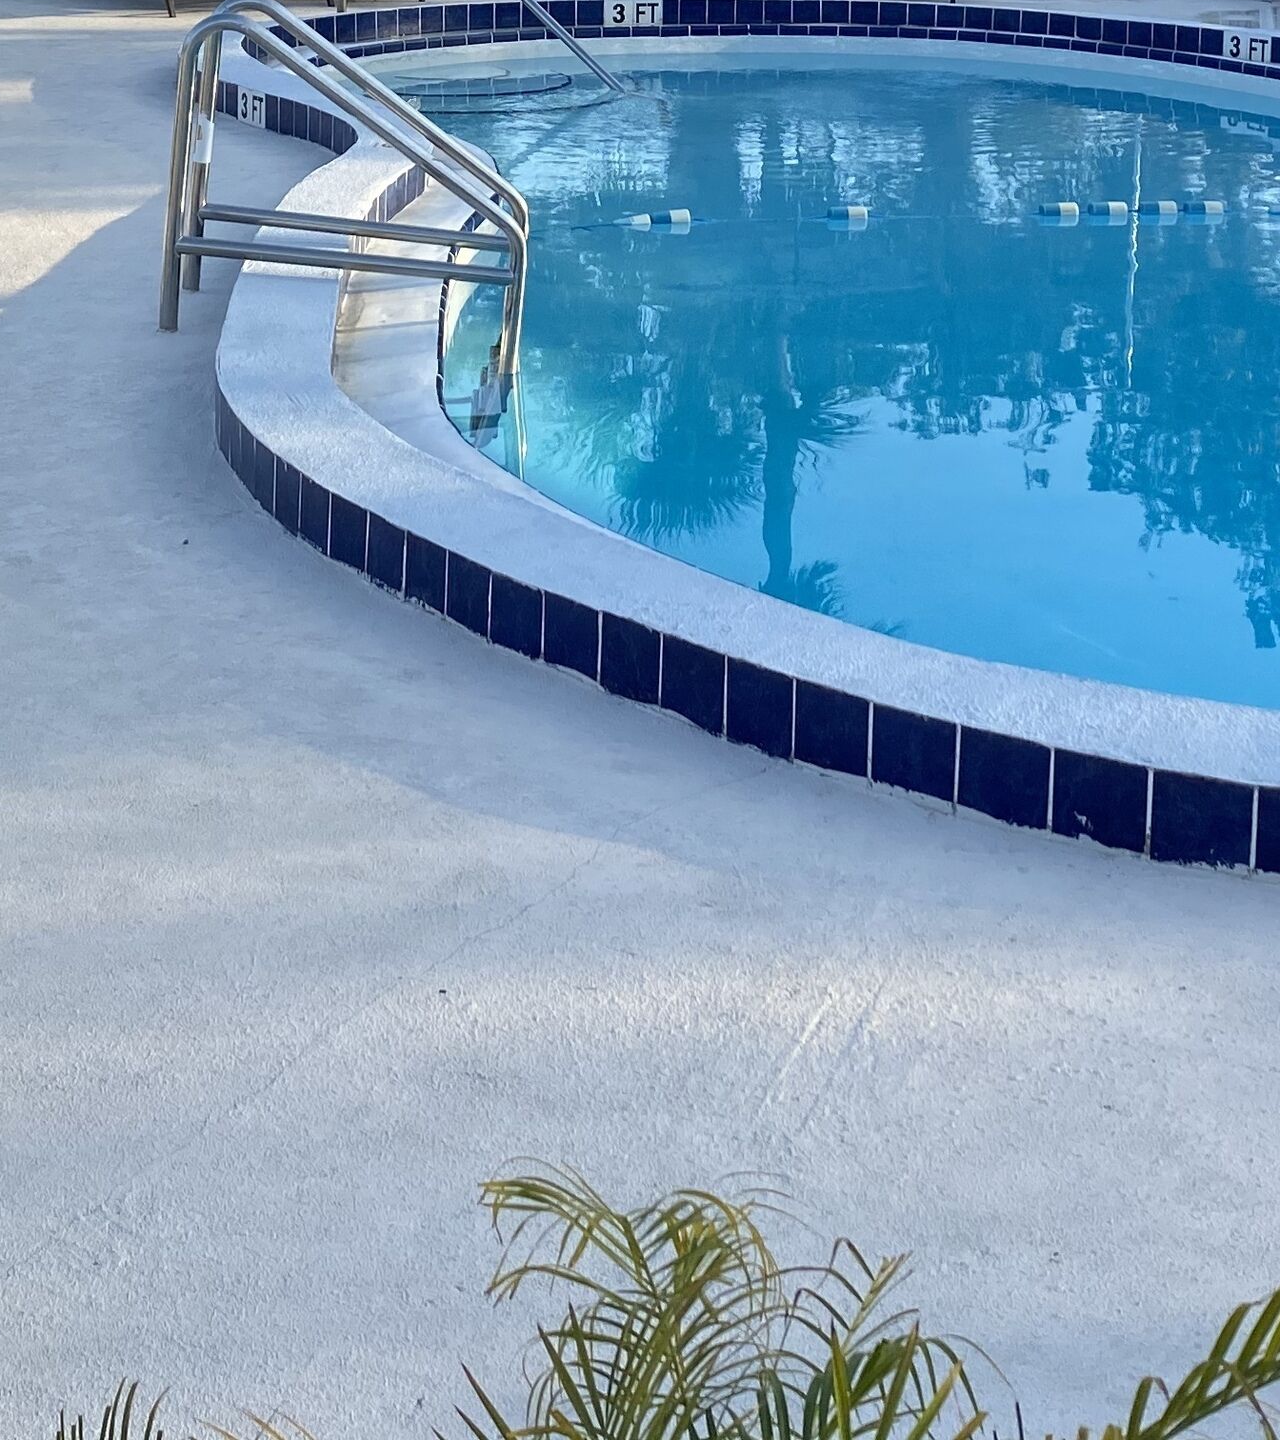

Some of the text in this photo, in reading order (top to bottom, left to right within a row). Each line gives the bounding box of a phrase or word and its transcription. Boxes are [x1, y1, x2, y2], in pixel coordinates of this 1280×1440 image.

[612, 3, 659, 24] 3 FT
[1229, 35, 1269, 62] 3 FT
[241, 92, 264, 124] 3 FT
